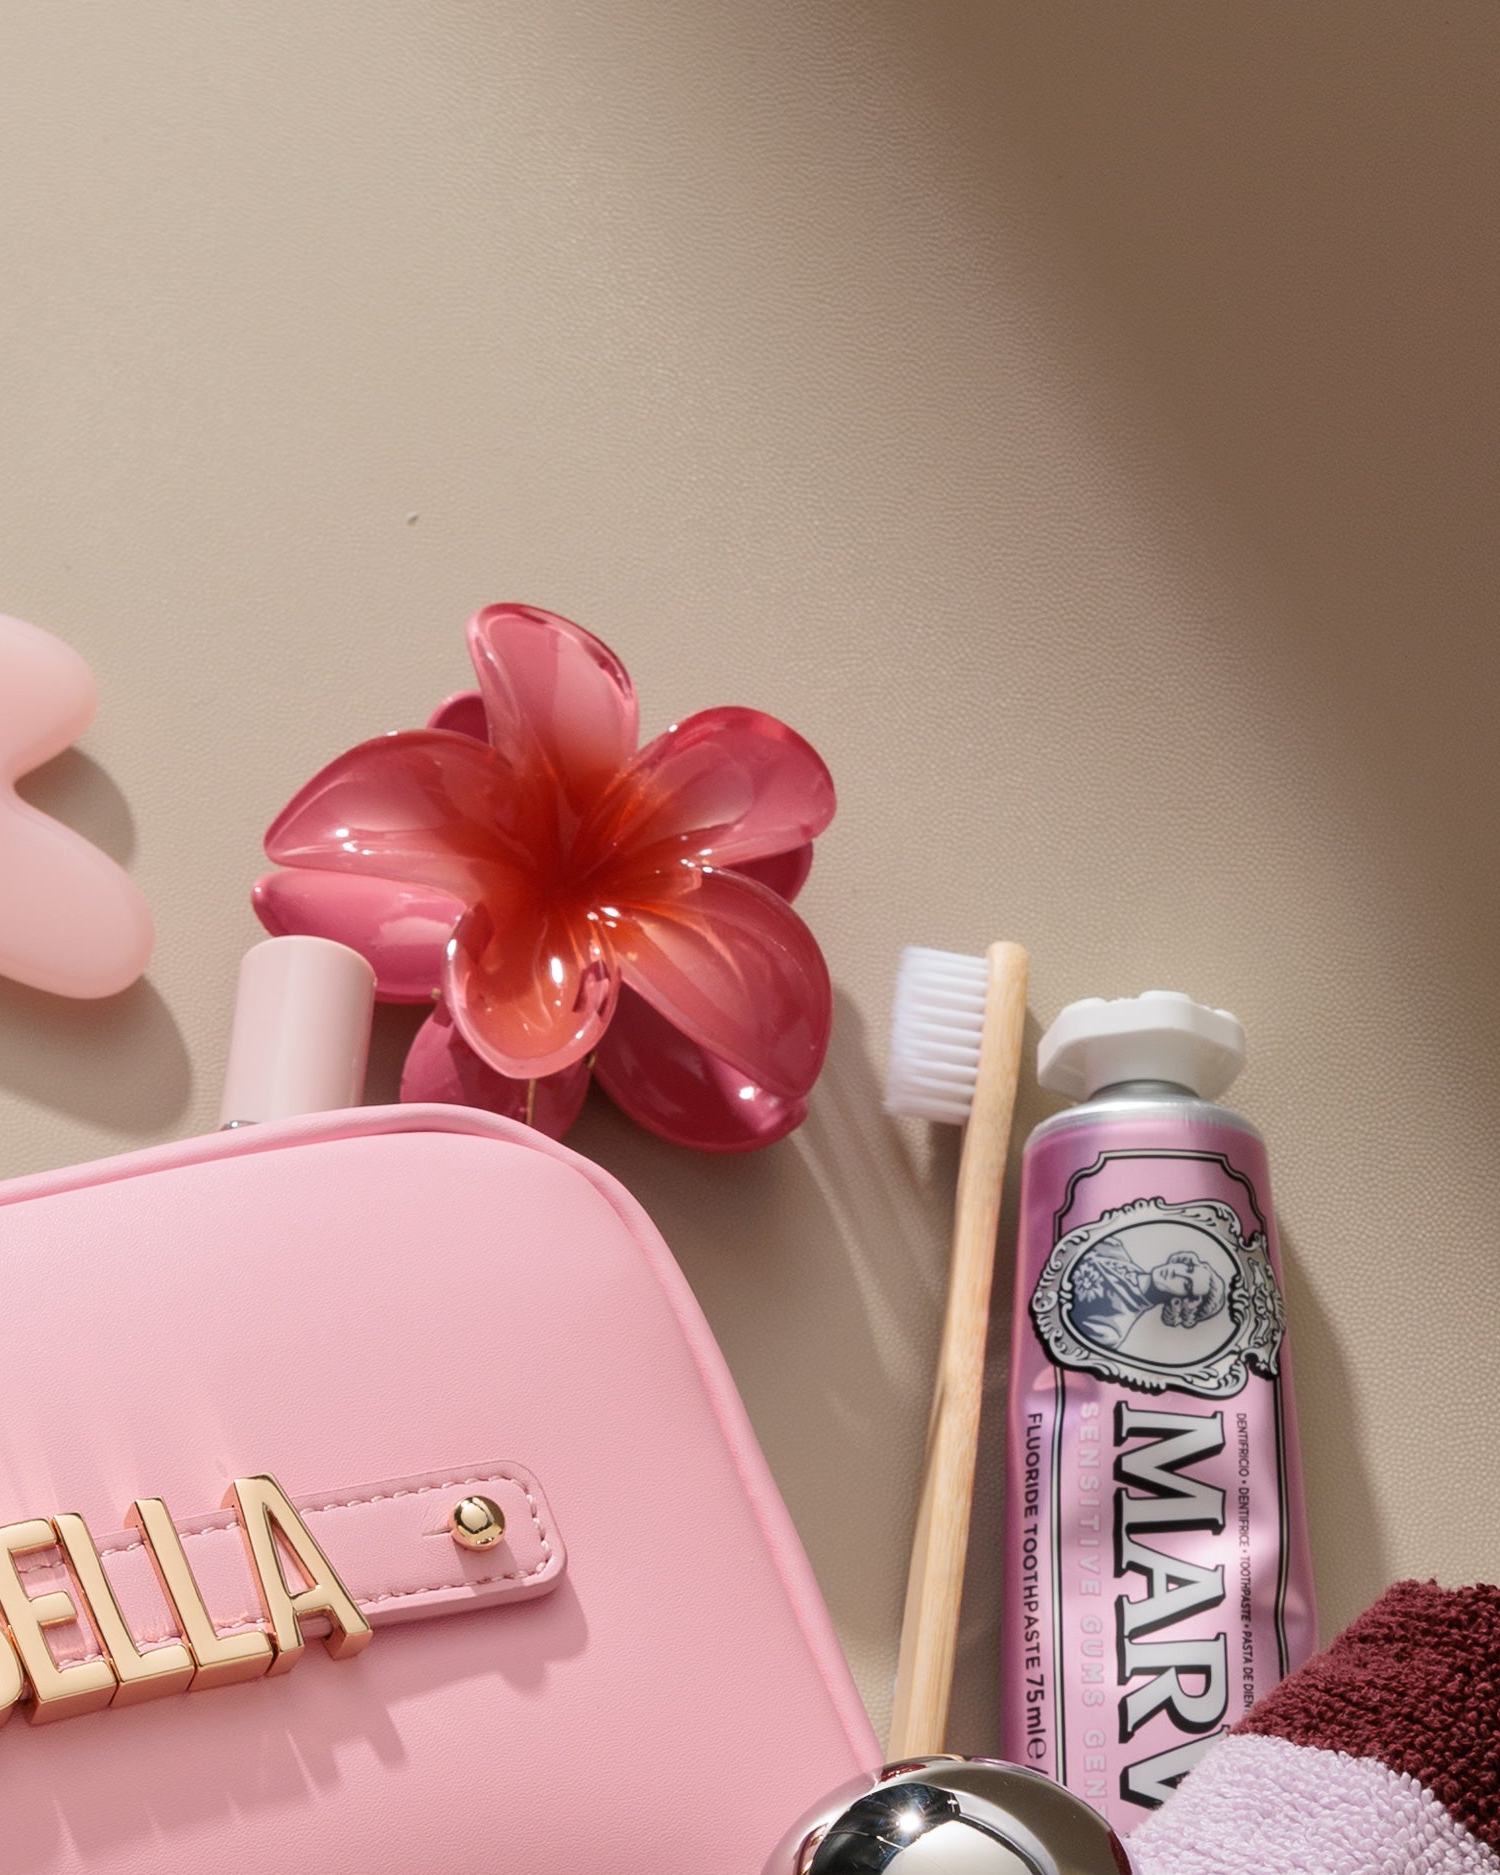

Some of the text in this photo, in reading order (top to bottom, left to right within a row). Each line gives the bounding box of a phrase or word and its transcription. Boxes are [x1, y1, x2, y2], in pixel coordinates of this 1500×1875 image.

[1023, 1413, 1043, 1519] FLUORIDE
[1236, 1412, 1255, 1713] DENTIFRICIO DENTIFRICE TOOTHPASTE PASTA DE DIEN
[1022, 1523, 1041, 1671] TOOTHPASTE
[1077, 1402, 1107, 1817] SENSITIVE GUMS GEN
